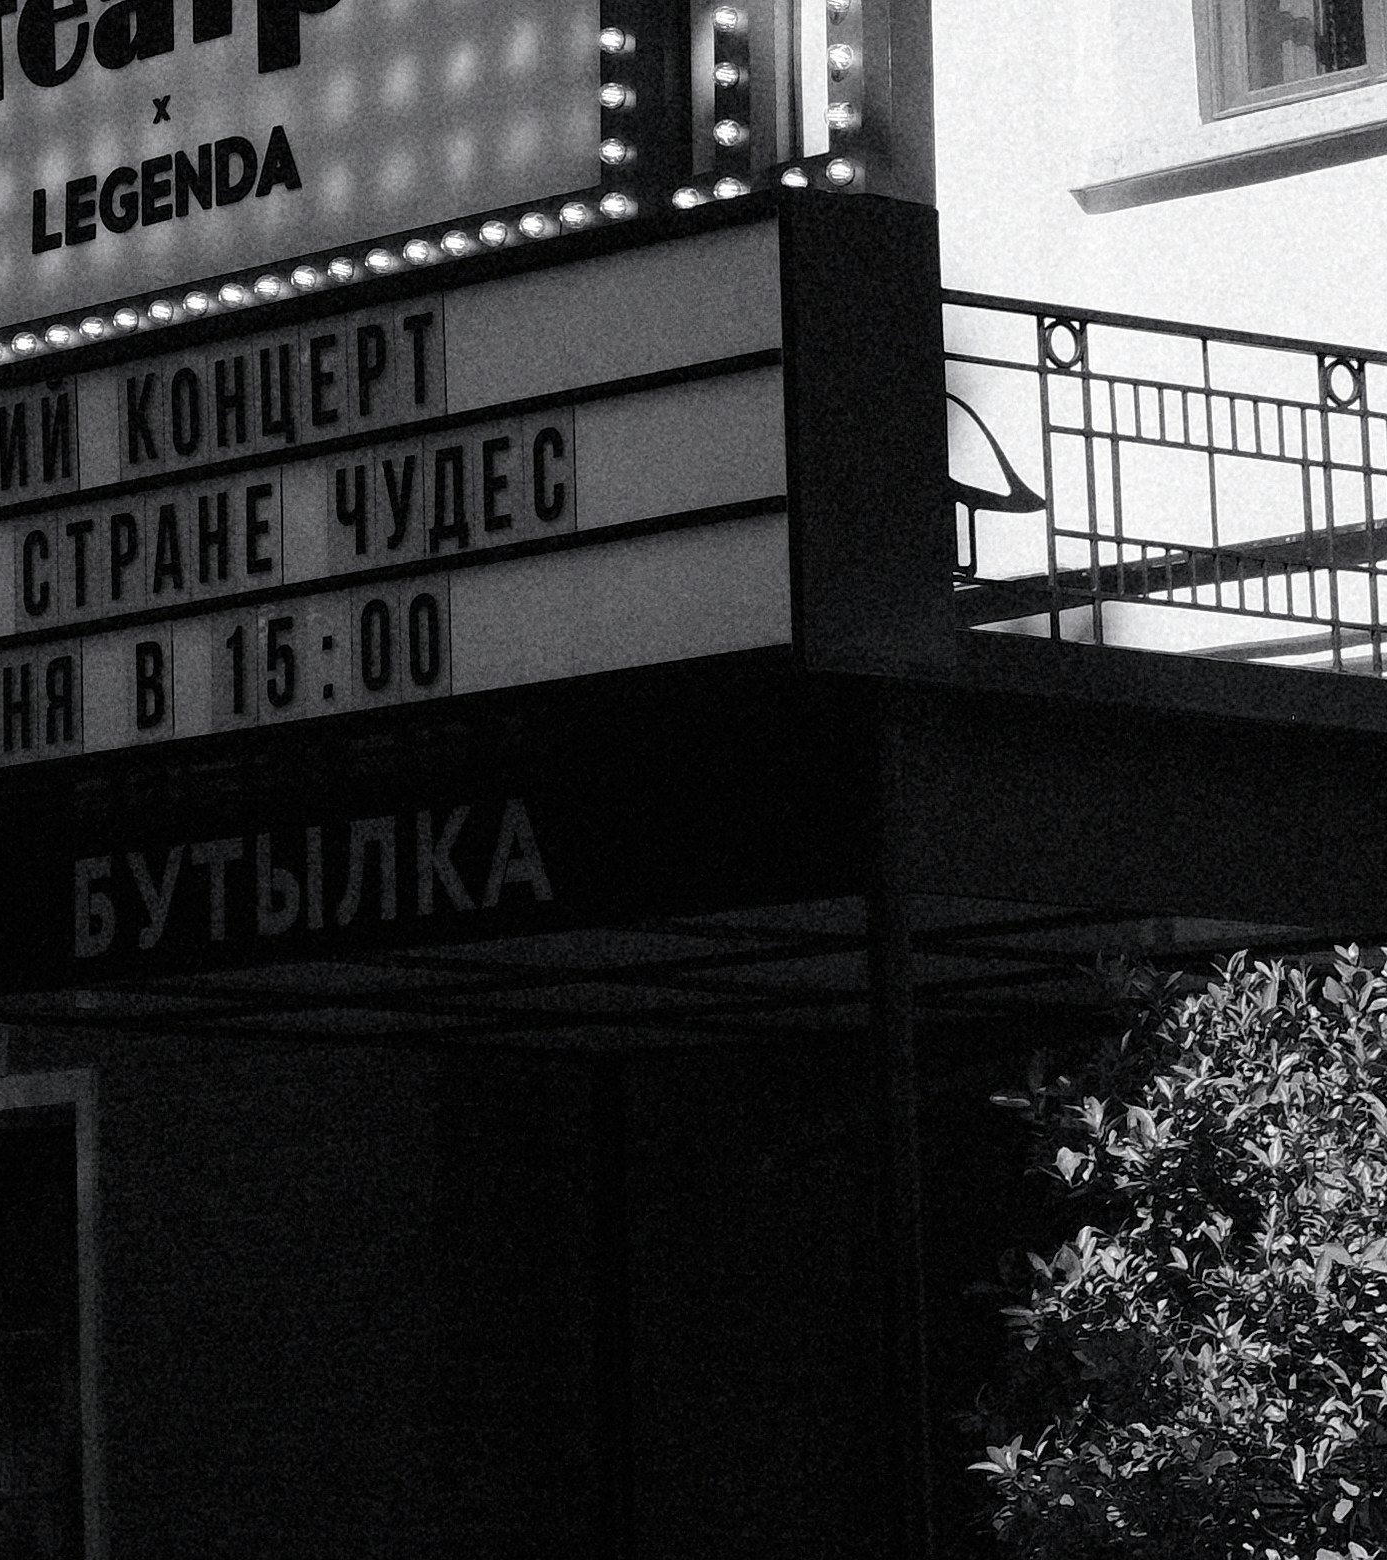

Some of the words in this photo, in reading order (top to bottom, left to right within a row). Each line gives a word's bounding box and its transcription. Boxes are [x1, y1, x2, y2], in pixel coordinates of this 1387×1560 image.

[31, 125, 302, 254] LEGENDA
[126, 311, 434, 464] КОНЦЕРТ
[22, 482, 274, 618] СТРАНЕ
[335, 425, 567, 556] ЧУДЕС
[136, 641, 164, 731] В
[227, 592, 441, 717] 15:00
[72, 797, 555, 960] БУТЫЛКА
